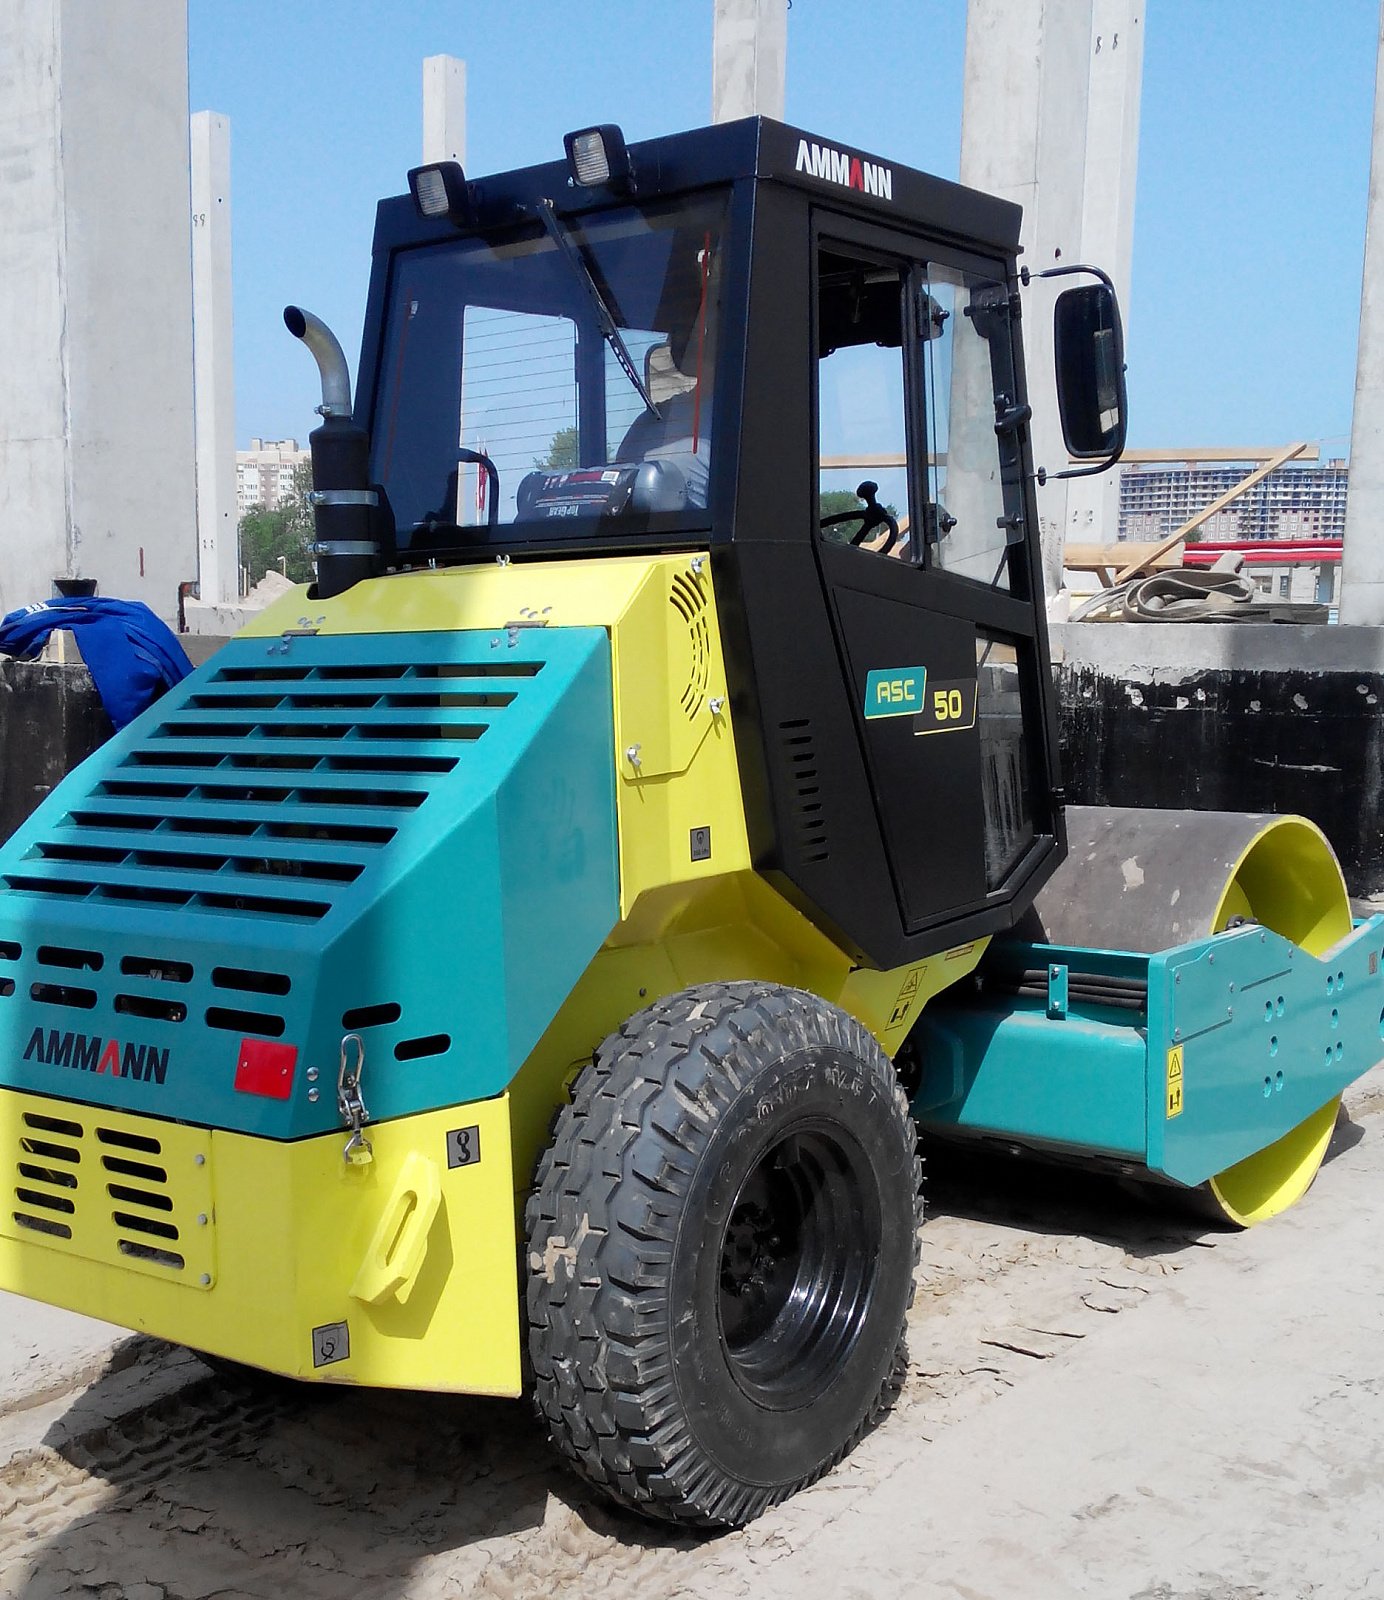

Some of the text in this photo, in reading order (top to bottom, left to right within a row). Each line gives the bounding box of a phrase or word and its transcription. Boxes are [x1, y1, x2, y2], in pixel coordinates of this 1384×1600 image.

[795, 139, 892, 200] AMMANN
[876, 679, 962, 720] ASC 50
[23, 1027, 170, 1084] AMMANN
